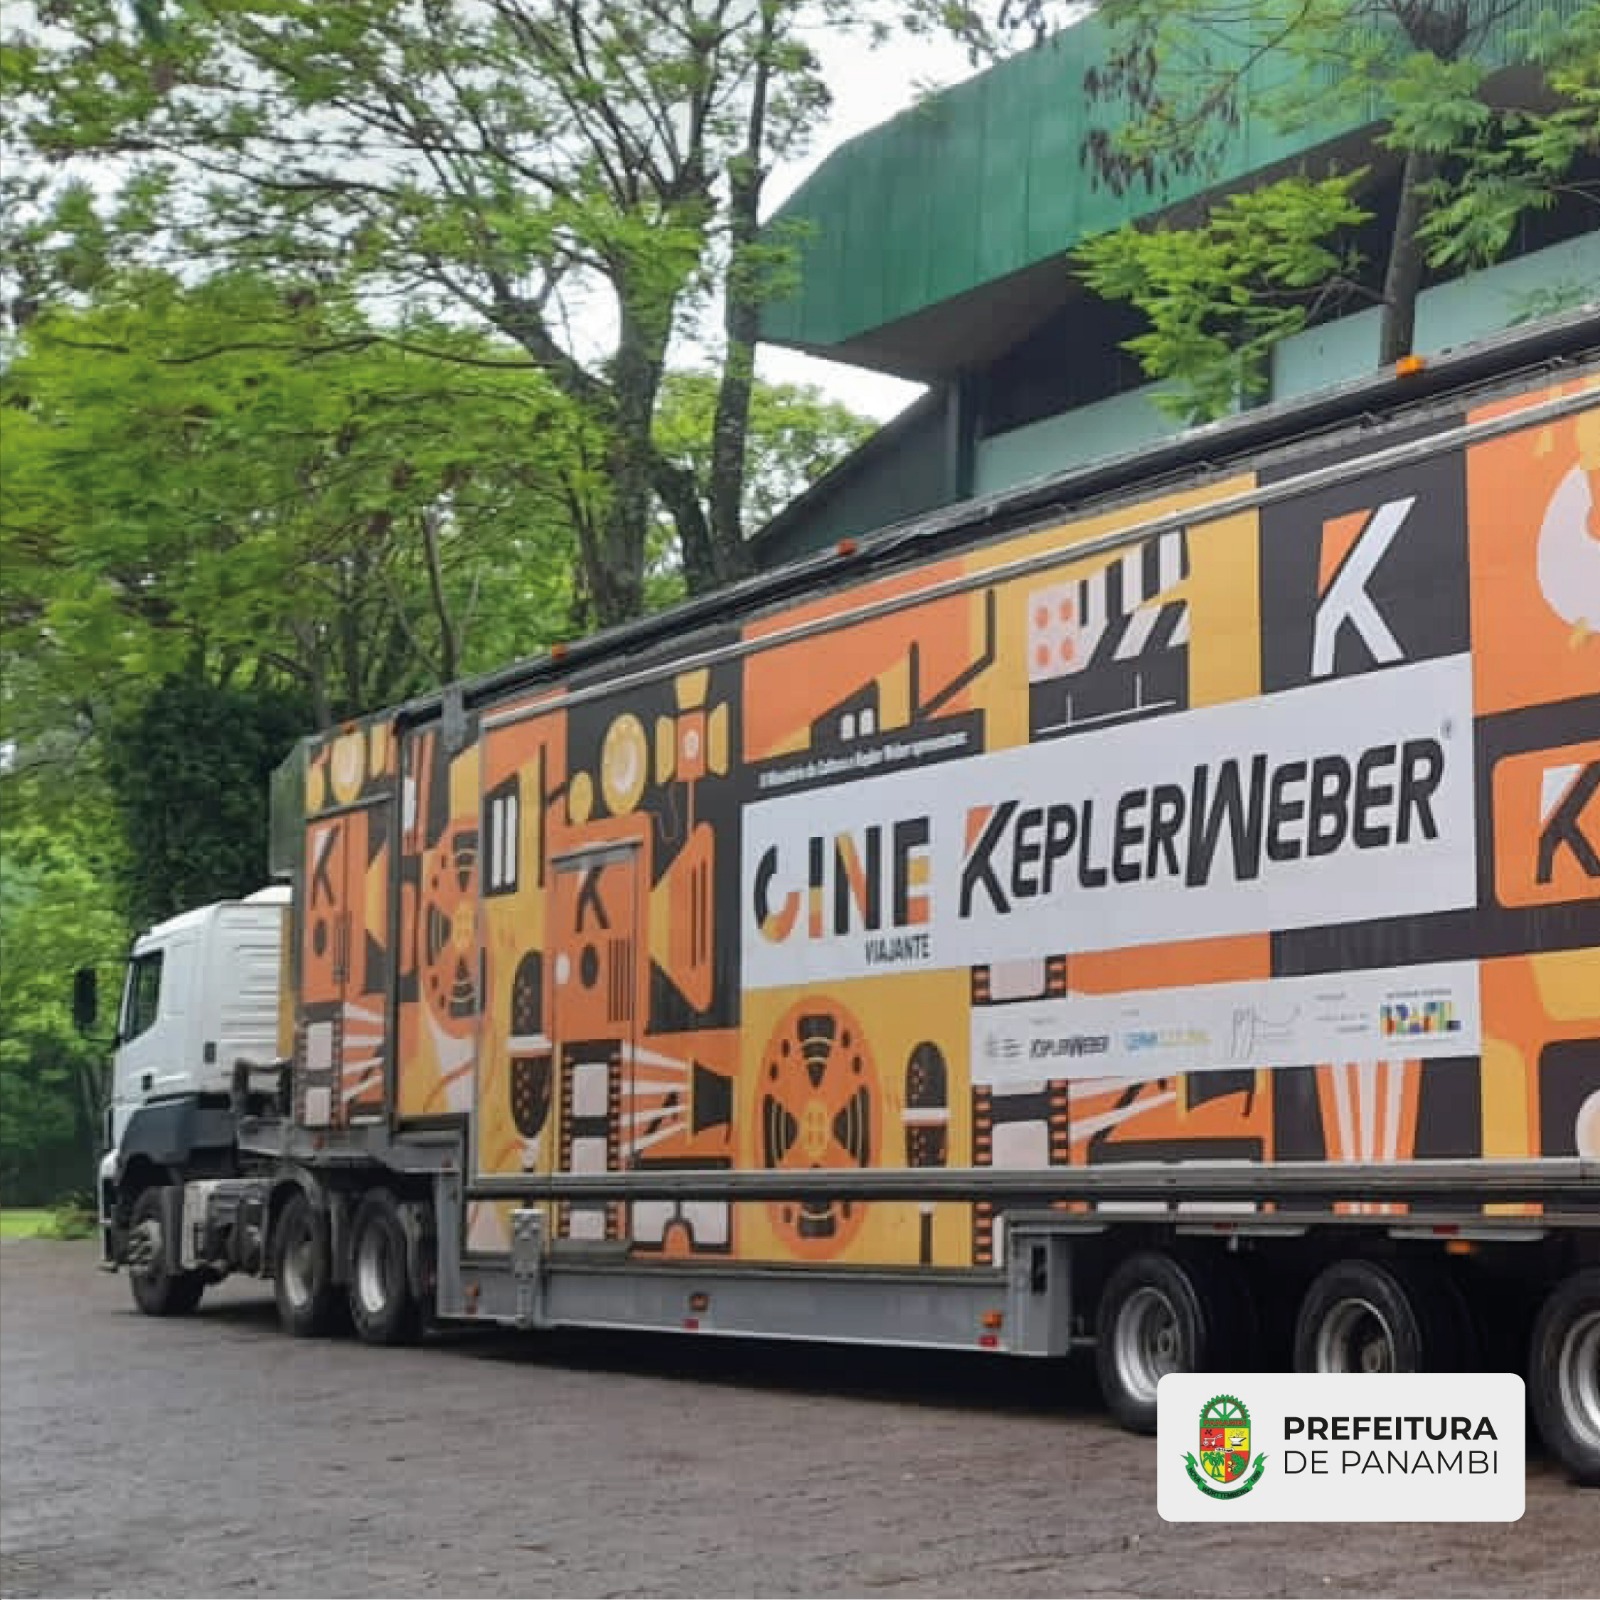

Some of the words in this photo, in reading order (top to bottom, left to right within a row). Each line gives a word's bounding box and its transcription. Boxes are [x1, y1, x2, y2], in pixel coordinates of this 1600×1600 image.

[1311, 496, 1415, 678] K
[753, 815, 931, 943] CINE
[1536, 760, 1600, 884] K
[865, 934, 931, 965] VIAJANTE
